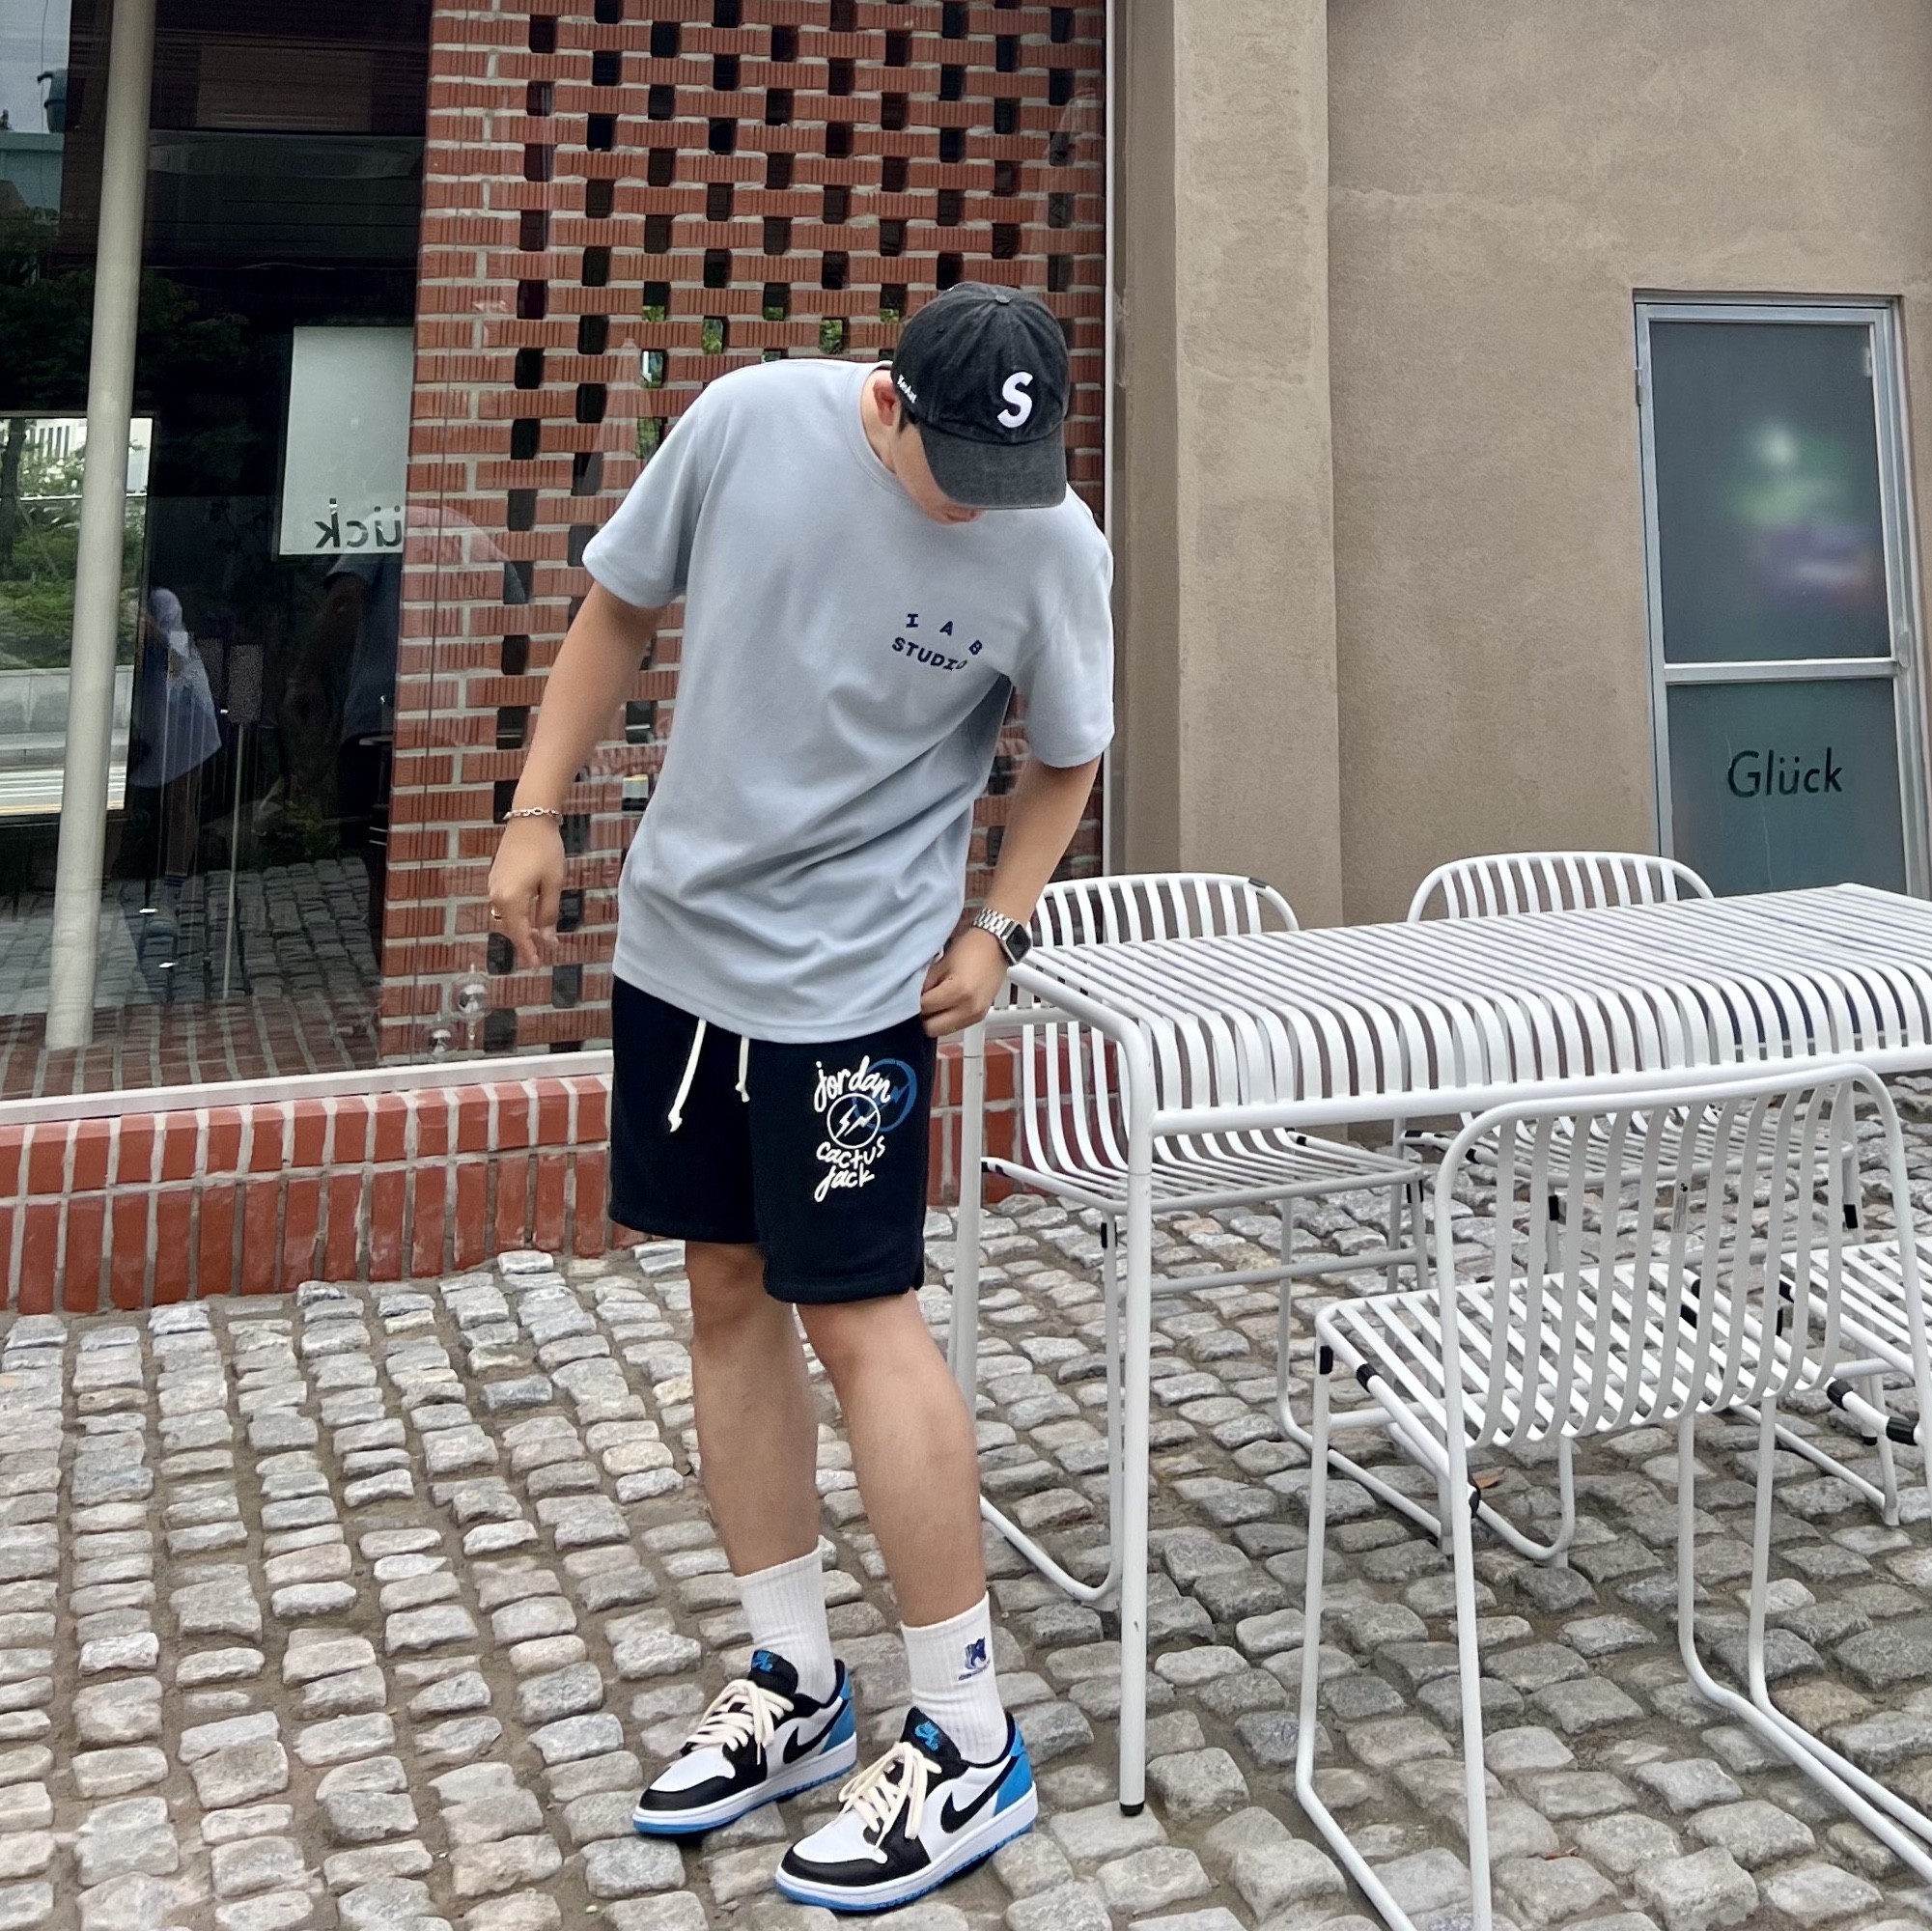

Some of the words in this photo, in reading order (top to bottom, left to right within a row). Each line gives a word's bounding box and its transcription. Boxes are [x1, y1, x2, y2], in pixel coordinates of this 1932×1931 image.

[996, 371, 1034, 429] S
[891, 636, 967, 671] STUDIO
[1727, 746, 1843, 798] Glück
[814, 1054, 891, 1112] jordan
